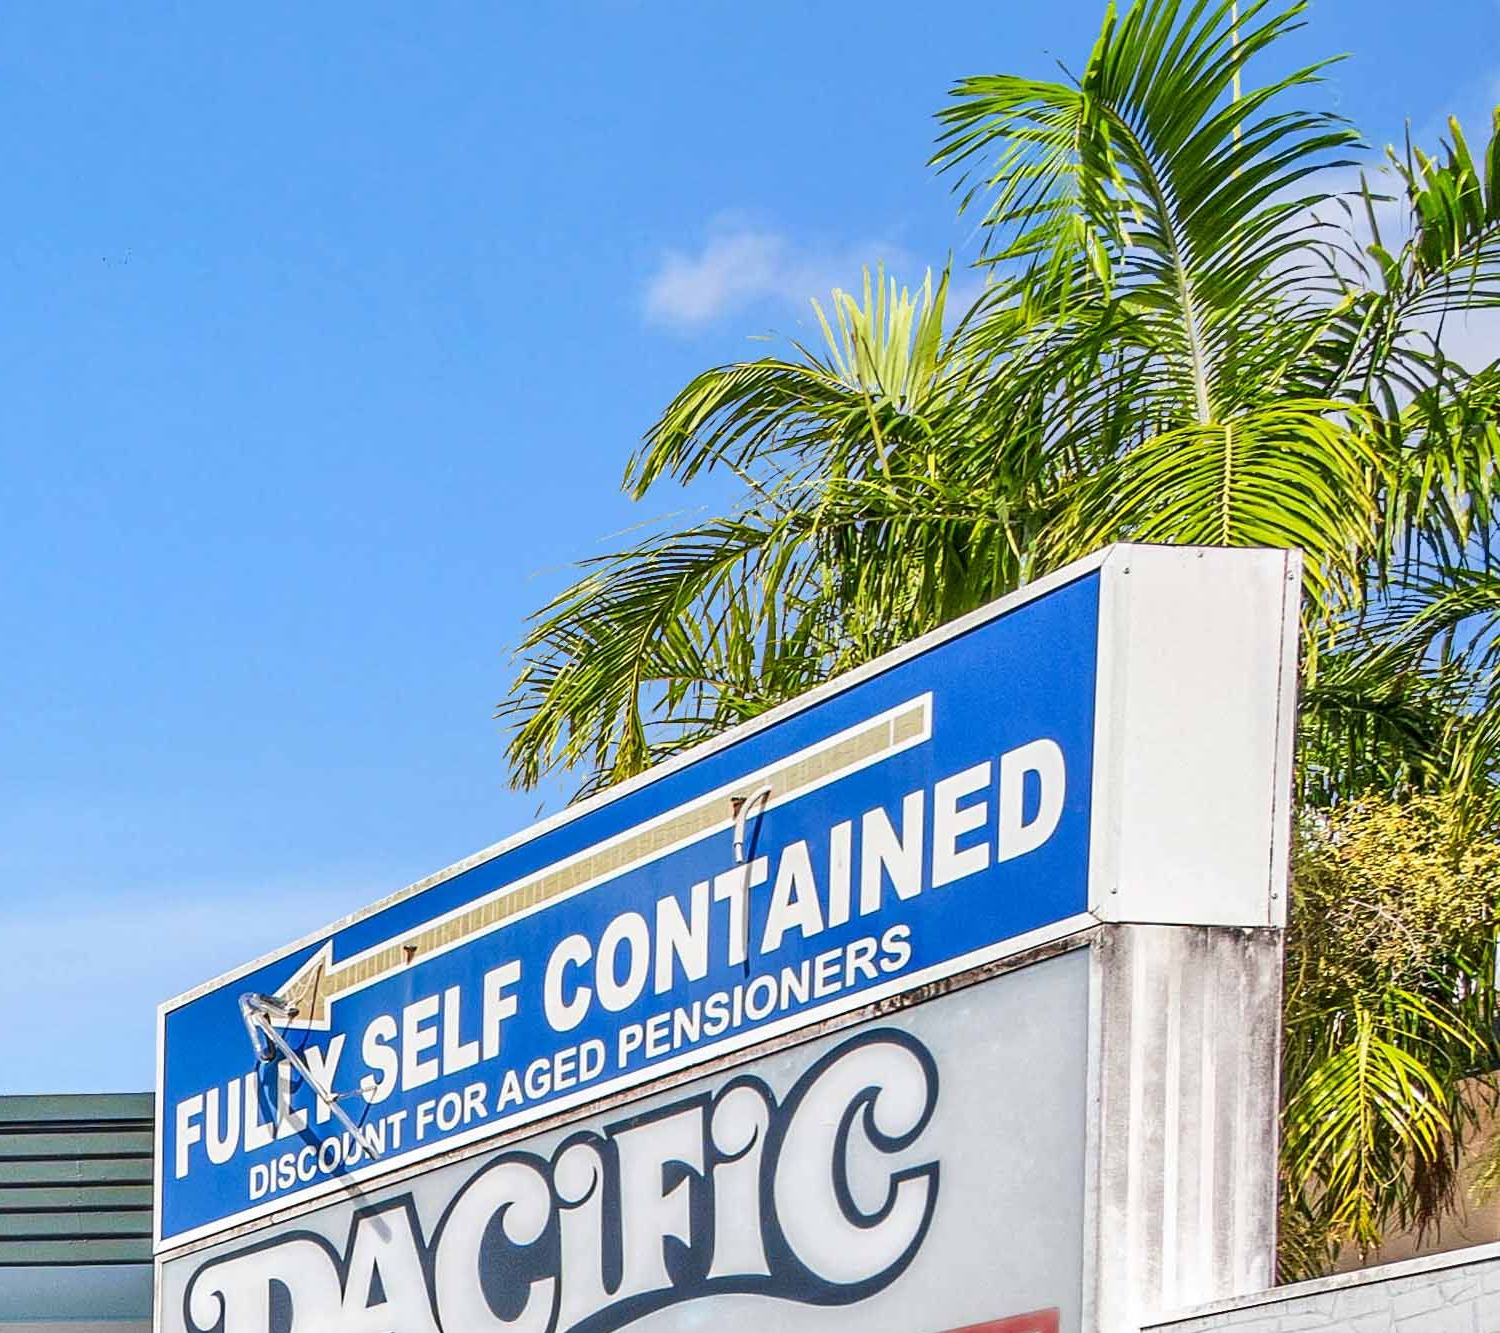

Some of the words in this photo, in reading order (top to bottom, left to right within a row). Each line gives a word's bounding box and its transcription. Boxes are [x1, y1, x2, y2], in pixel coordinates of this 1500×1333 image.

[175, 1036, 346, 1180] FULLY
[360, 958, 522, 1102] SELF
[543, 737, 1067, 1034] CONTAINED
[248, 1117, 404, 1200] DISCOUNT
[416, 1080, 487, 1147] FOR
[496, 1035, 605, 1111] AGED
[616, 922, 912, 1070] PENSIONERS
